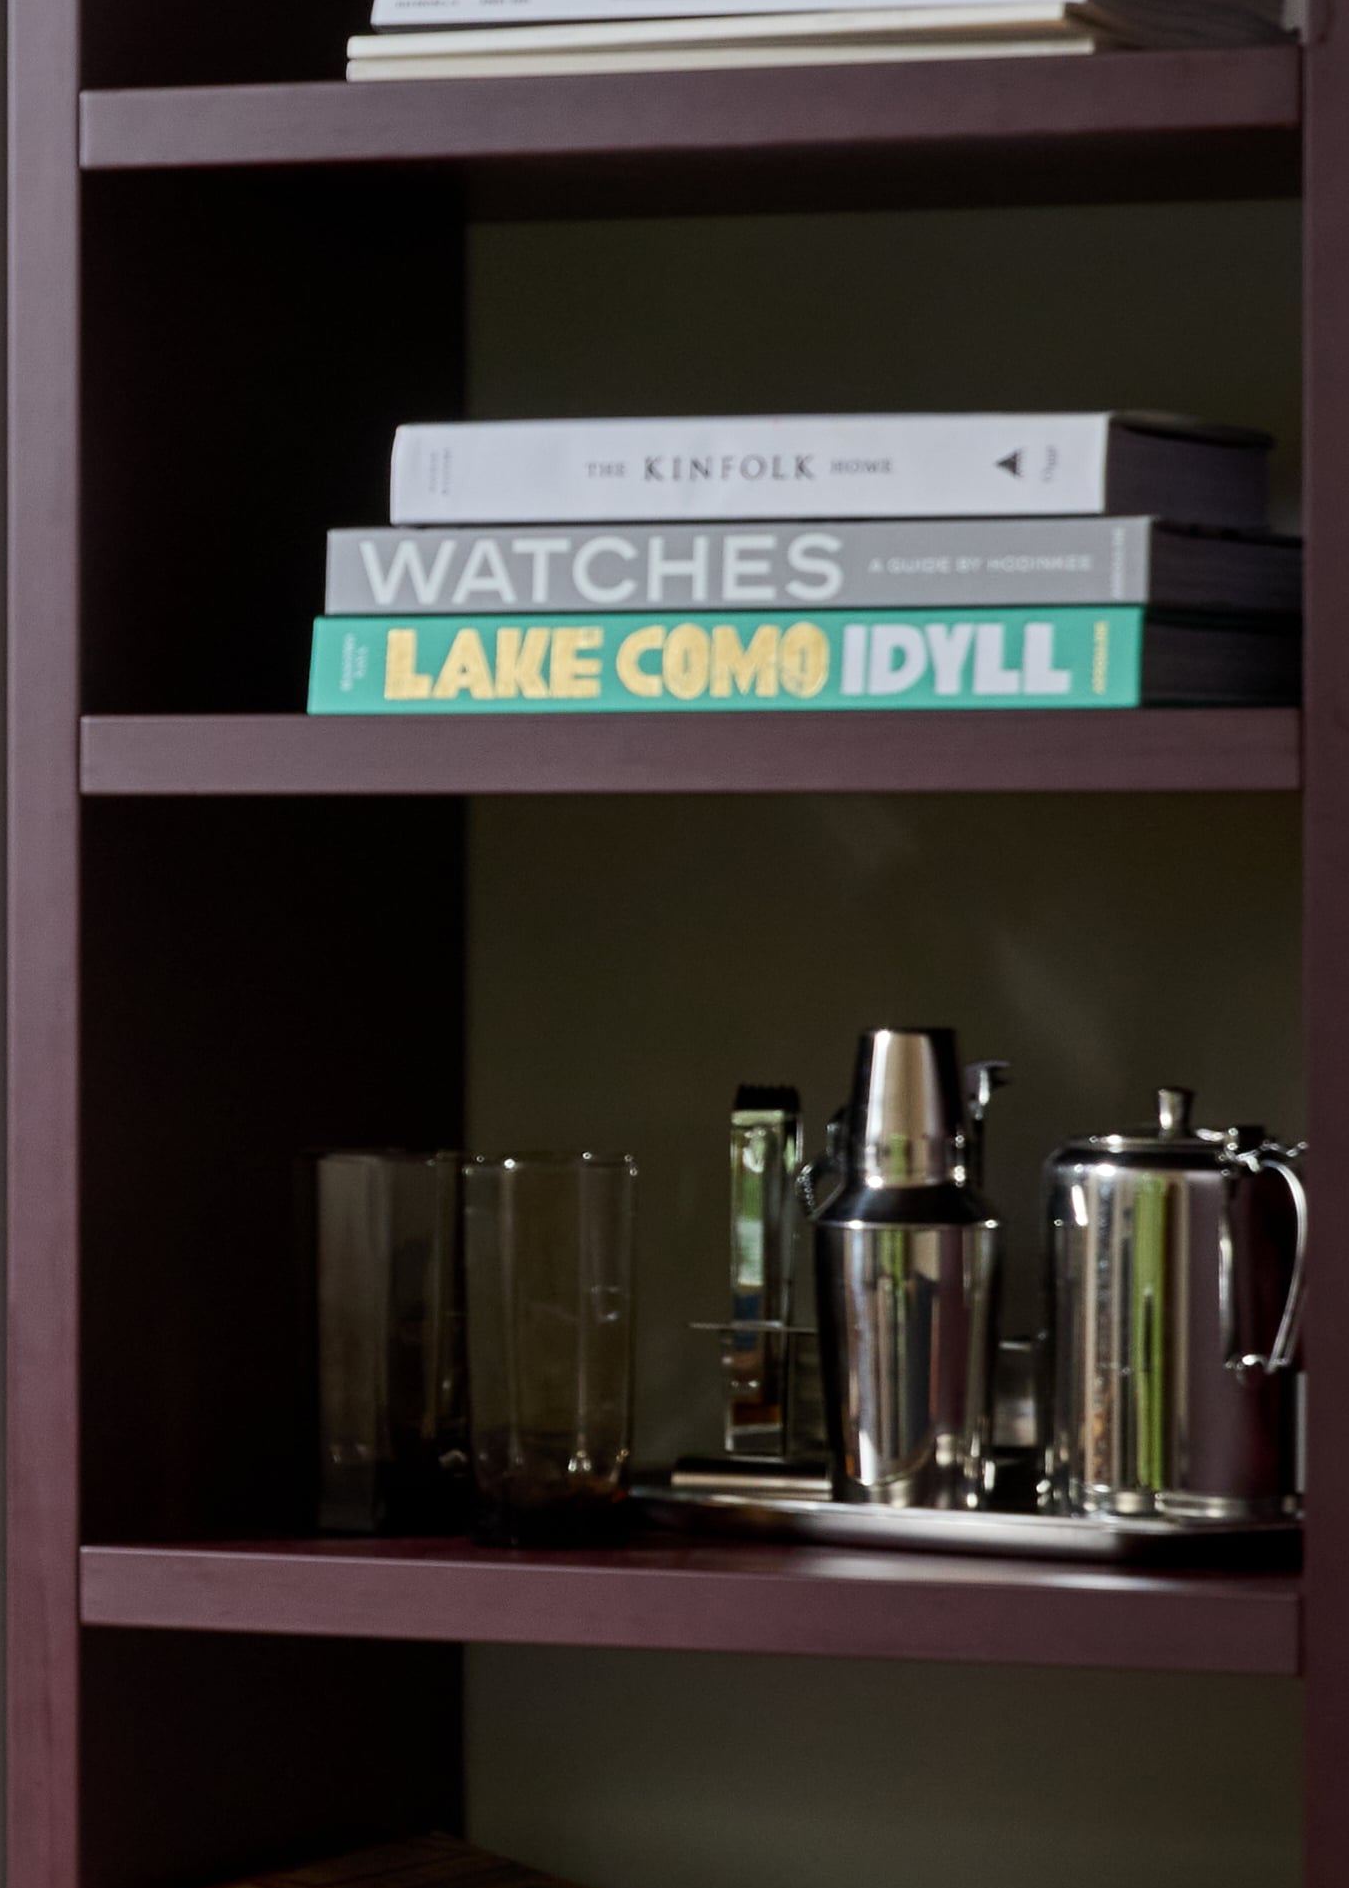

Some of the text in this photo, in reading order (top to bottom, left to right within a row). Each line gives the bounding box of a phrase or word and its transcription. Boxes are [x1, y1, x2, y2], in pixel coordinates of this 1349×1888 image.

[586, 454, 893, 482] THE KINFOLK HOME
[359, 532, 844, 606] WATCHES
[868, 557, 884, 573] A
[886, 556, 951, 574] GUIDE
[955, 556, 983, 573] BY
[383, 625, 604, 701] LAKE
[615, 621, 830, 701] COMO
[839, 622, 1072, 695] IDYLL
